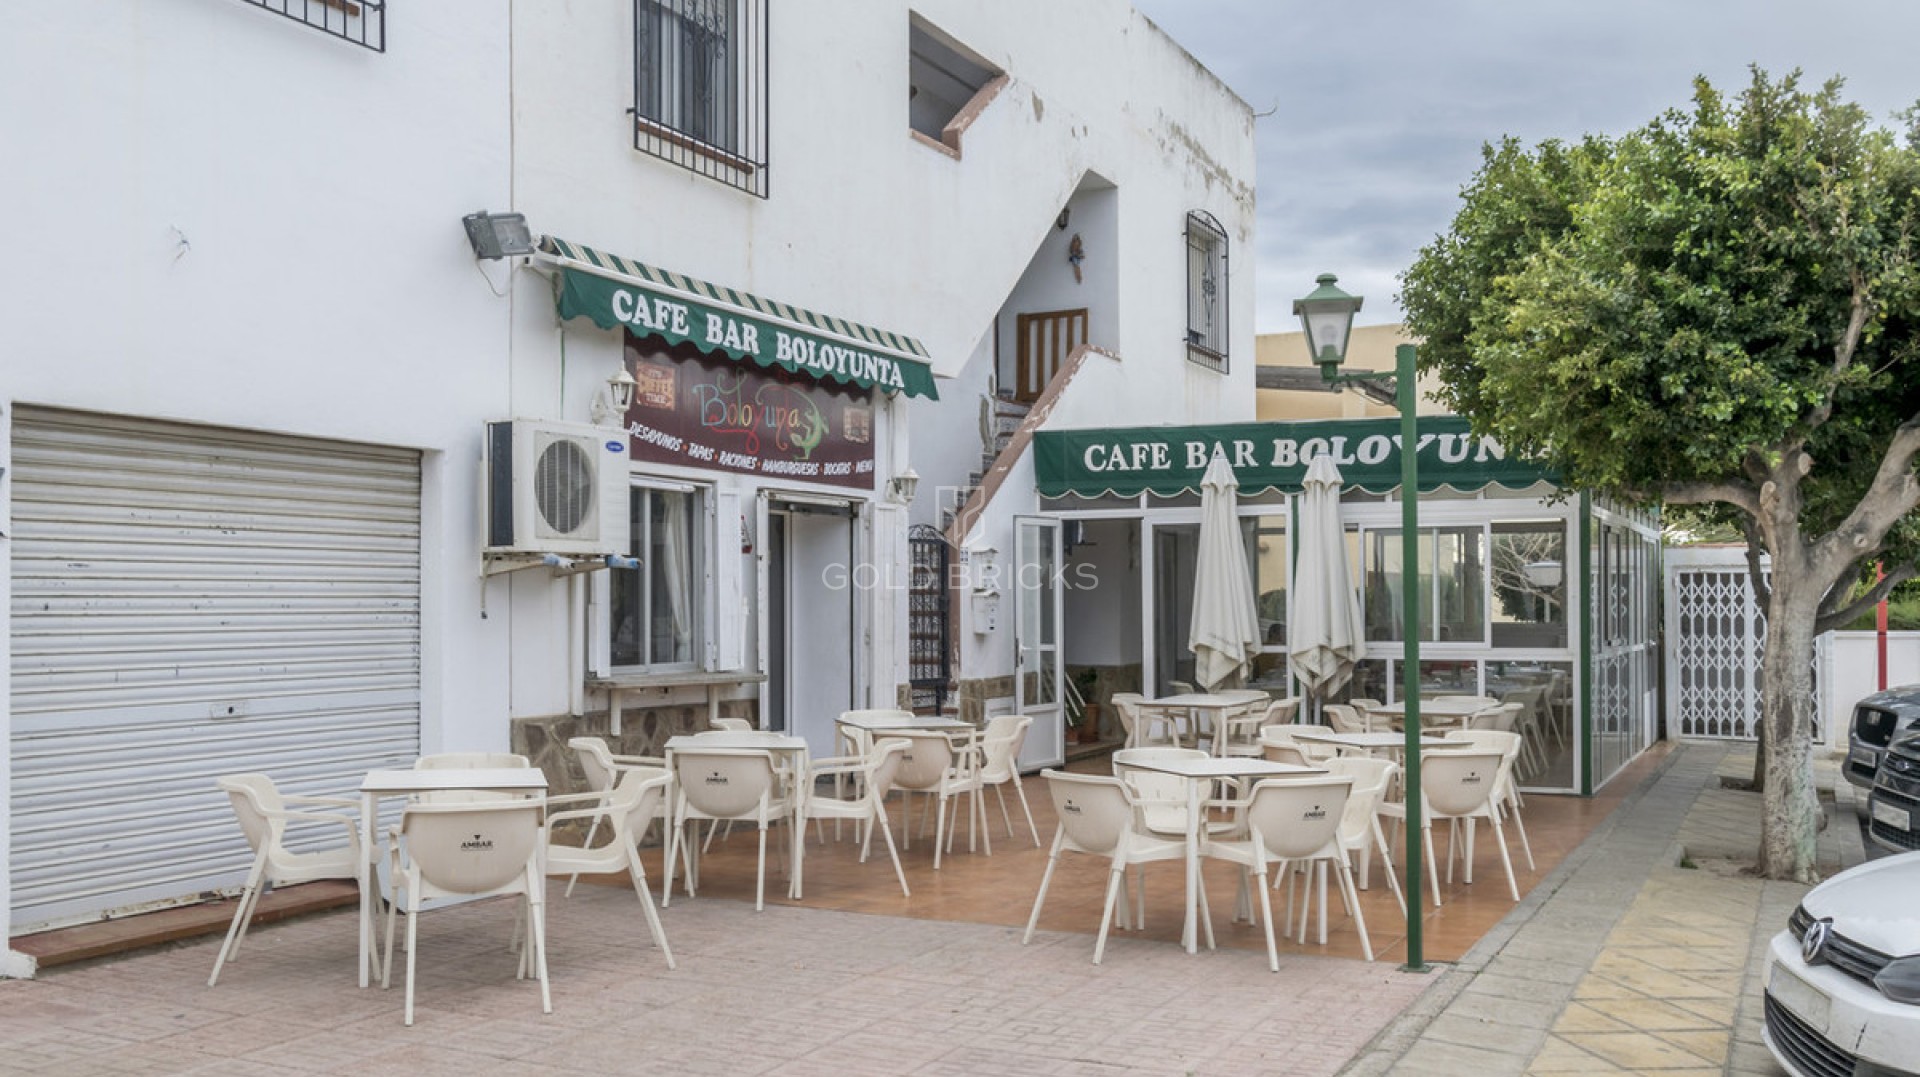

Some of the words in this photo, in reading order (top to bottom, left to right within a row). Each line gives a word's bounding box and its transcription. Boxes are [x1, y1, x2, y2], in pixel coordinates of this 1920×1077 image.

[612, 289, 689, 336] CAFE
[706, 313, 760, 354] BAR
[776, 331, 905, 388] BOLOYUNTA
[688, 442, 714, 461] TAPAS
[718, 451, 757, 470] RACIONES
[1084, 442, 1172, 472] CAFE
[1185, 440, 1259, 468] BAR
